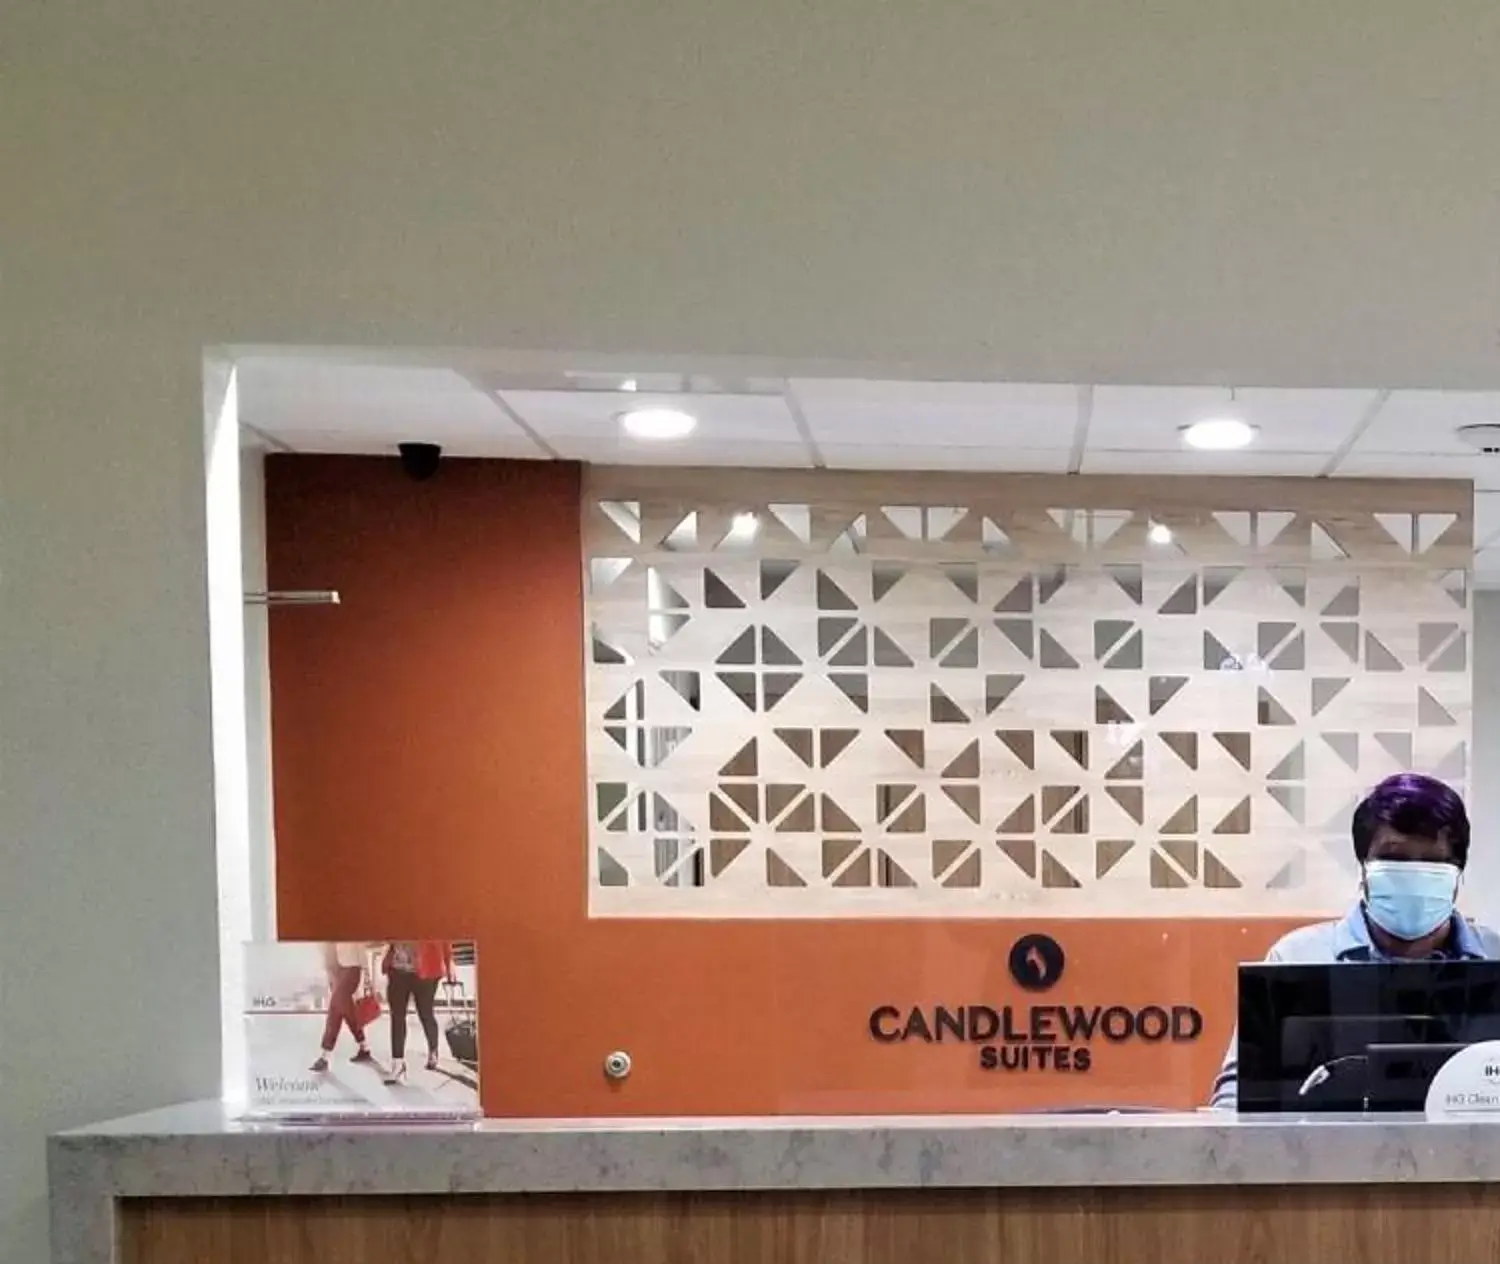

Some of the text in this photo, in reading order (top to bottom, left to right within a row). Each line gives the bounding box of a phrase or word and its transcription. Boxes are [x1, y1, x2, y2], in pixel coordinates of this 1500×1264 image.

[868, 1005, 1203, 1042] CANDLEWOOD
[979, 1046, 1091, 1072] SUITES
[1467, 1093, 1499, 1105] Clean
